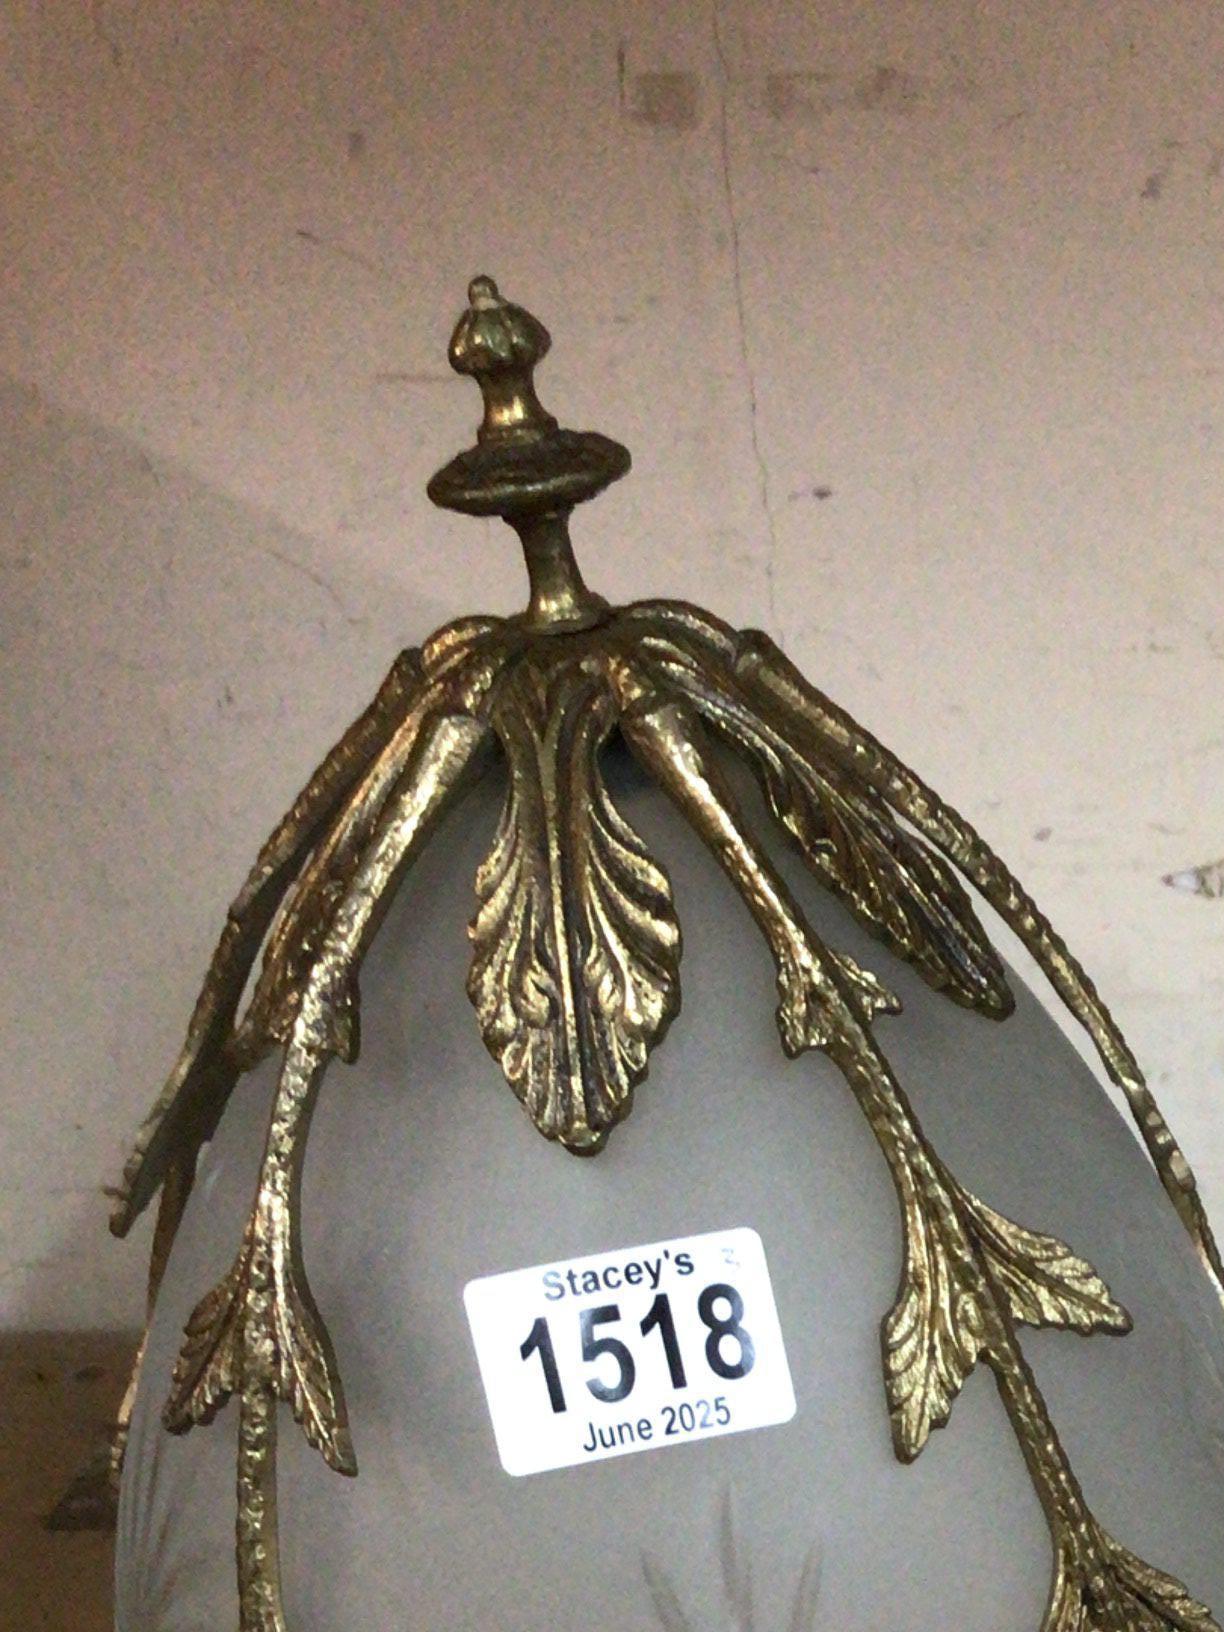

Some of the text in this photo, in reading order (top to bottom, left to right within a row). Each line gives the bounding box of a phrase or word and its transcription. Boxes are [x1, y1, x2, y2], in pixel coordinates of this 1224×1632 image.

[542, 1250, 695, 1301] Stacey's
[520, 1283, 756, 1414] 1518
[583, 1397, 731, 1452] June 2025
